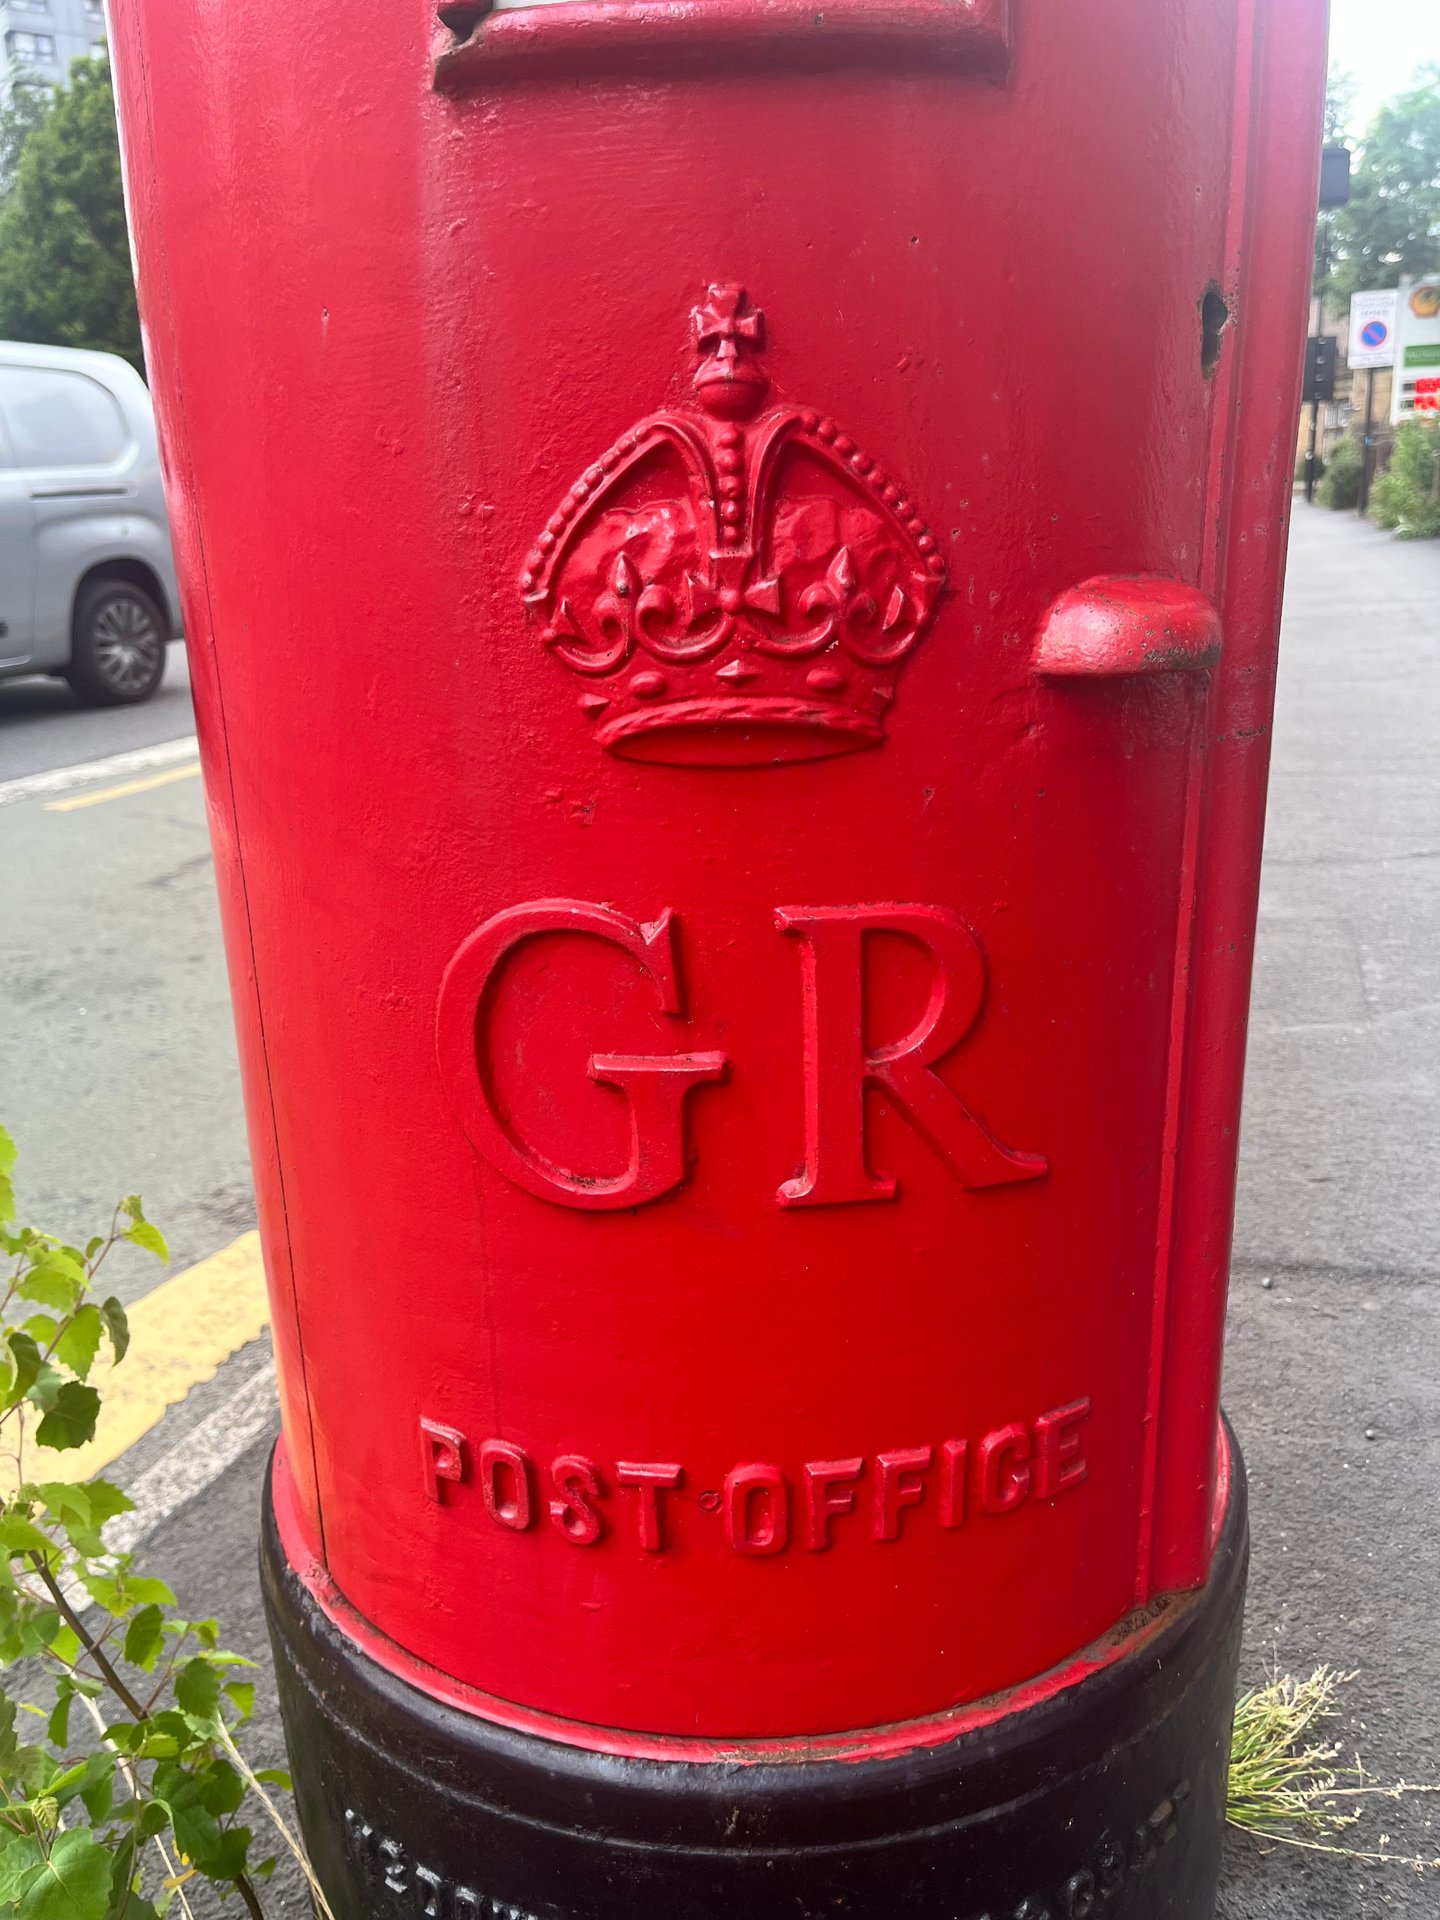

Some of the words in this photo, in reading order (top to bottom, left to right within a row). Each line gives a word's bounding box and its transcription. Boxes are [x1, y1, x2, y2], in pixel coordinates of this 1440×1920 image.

[436, 897, 1049, 1212] GR
[418, 1414, 684, 1553] POST
[723, 1395, 1092, 1556] OFFICE
